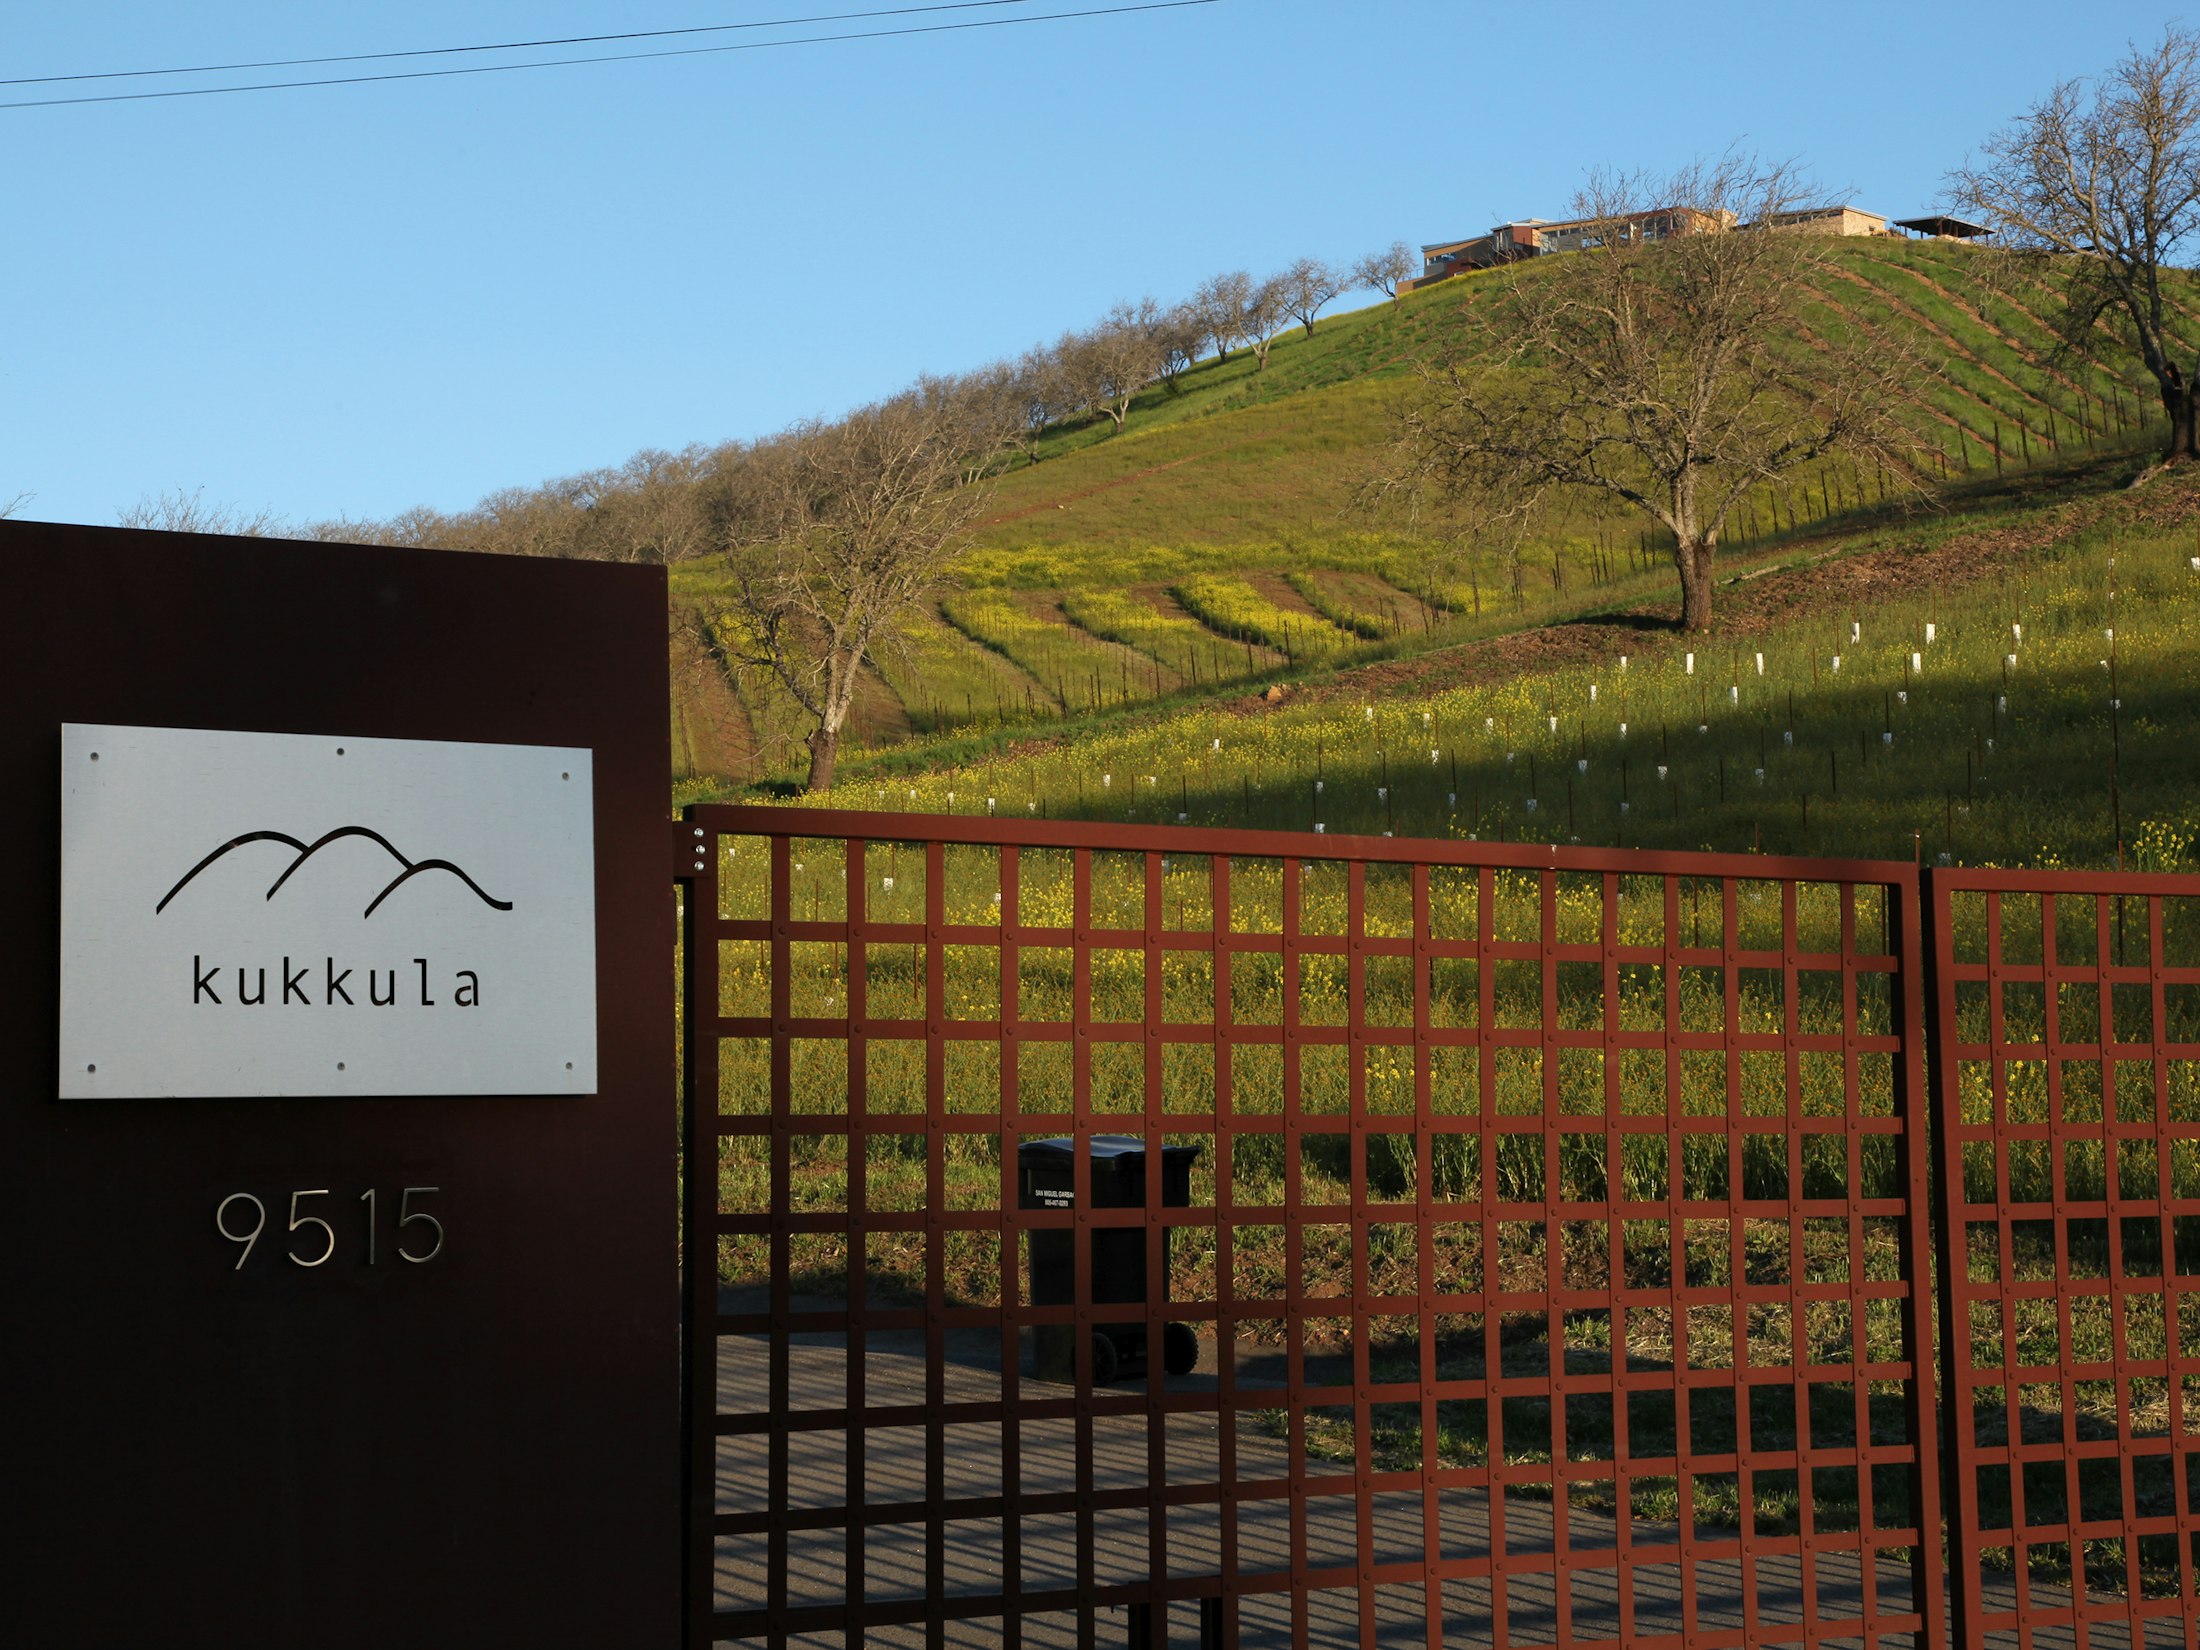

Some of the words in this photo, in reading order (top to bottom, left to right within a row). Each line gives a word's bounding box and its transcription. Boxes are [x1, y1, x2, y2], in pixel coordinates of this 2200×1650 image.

[193, 954, 480, 1007] kukkula
[1035, 1189, 1044, 1197] SAN
[1044, 1190, 1059, 1198] MIGUEL
[216, 1187, 444, 1270] 9515
